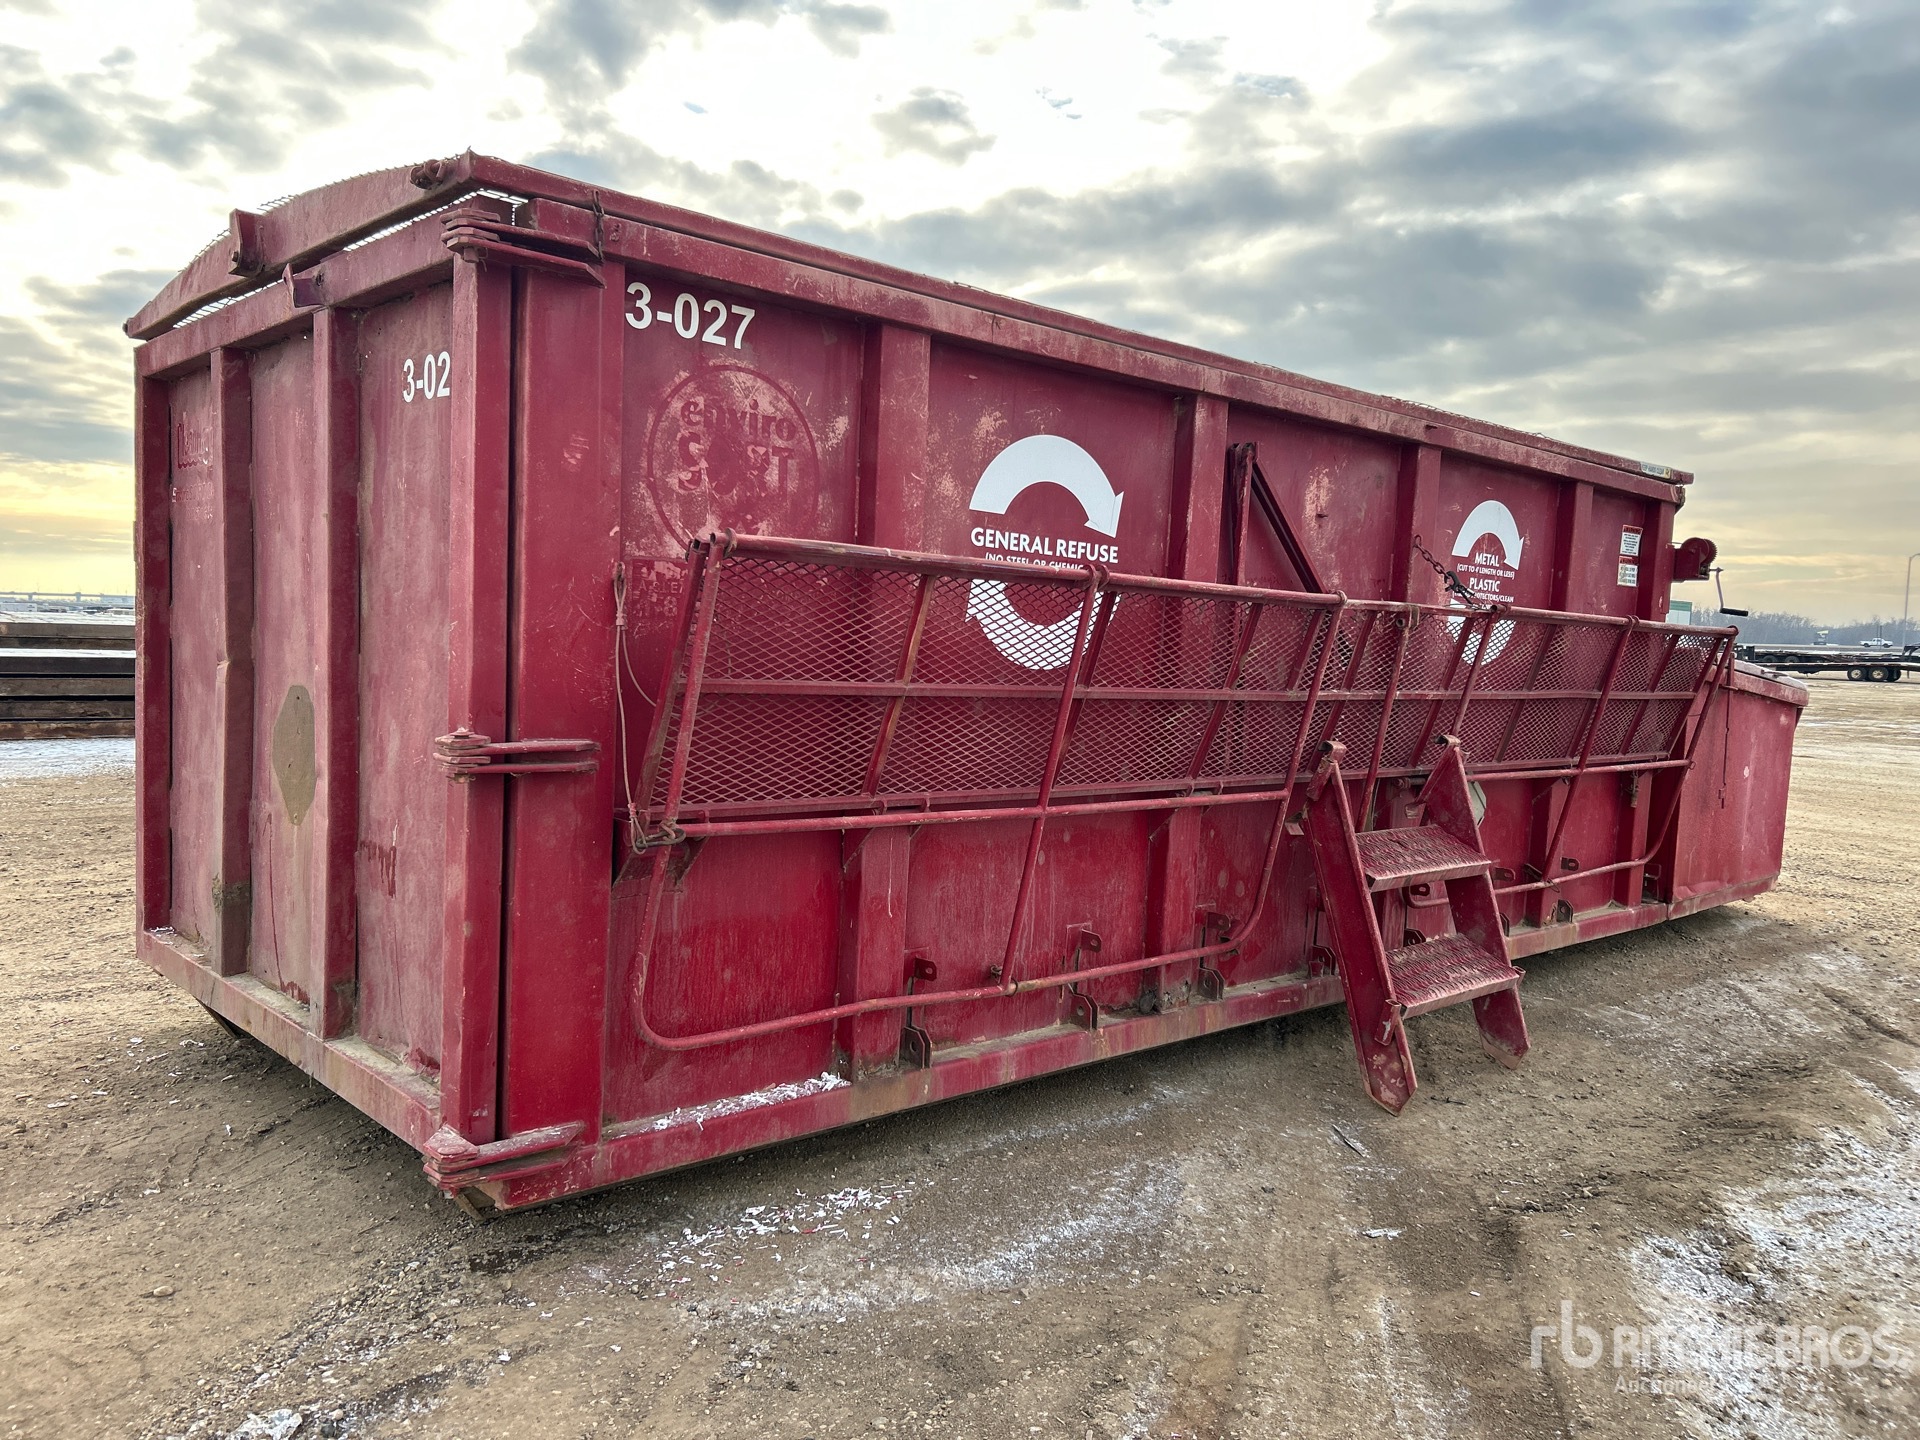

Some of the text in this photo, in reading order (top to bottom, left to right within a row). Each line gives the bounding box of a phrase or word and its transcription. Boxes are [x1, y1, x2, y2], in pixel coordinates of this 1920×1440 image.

[625, 281, 756, 350] 3-027
[971, 527, 1119, 564] GENERAL REFUSE
[1475, 552, 1499, 567] METAL
[1468, 565, 1475, 573] TO
[1479, 567, 1497, 576] LENGTH
[1497, 569, 1504, 577] OR
[1469, 577, 1500, 592] PLASTIC
